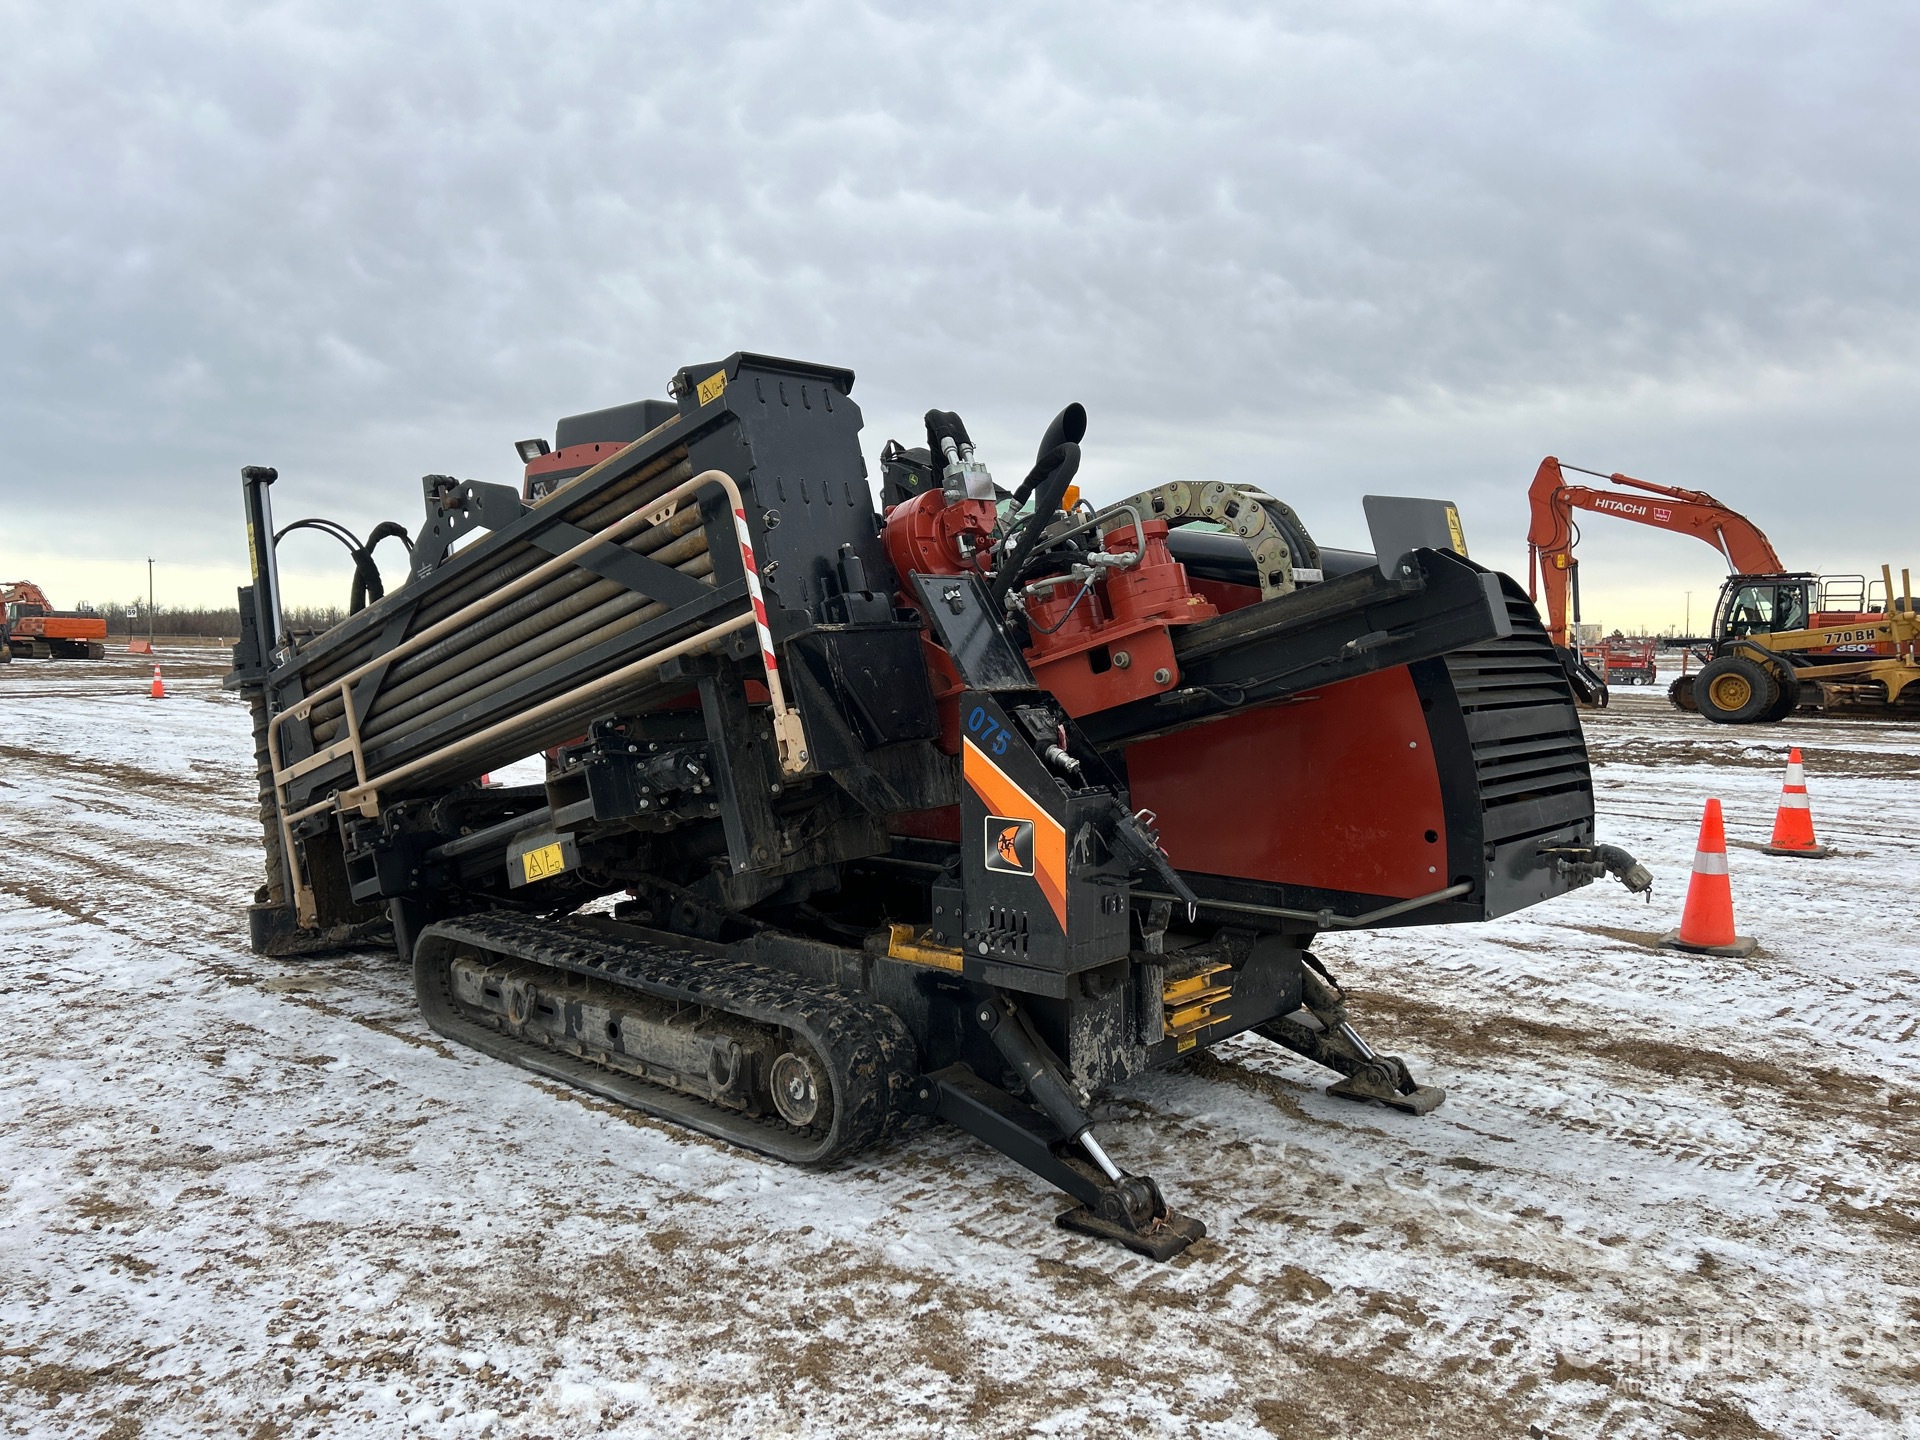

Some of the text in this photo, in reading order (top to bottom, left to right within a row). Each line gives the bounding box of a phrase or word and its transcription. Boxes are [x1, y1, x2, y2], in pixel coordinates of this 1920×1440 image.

[1595, 498, 1647, 516] HITACHI
[1824, 629, 1876, 645] 770 BH
[968, 706, 1012, 755] 075
